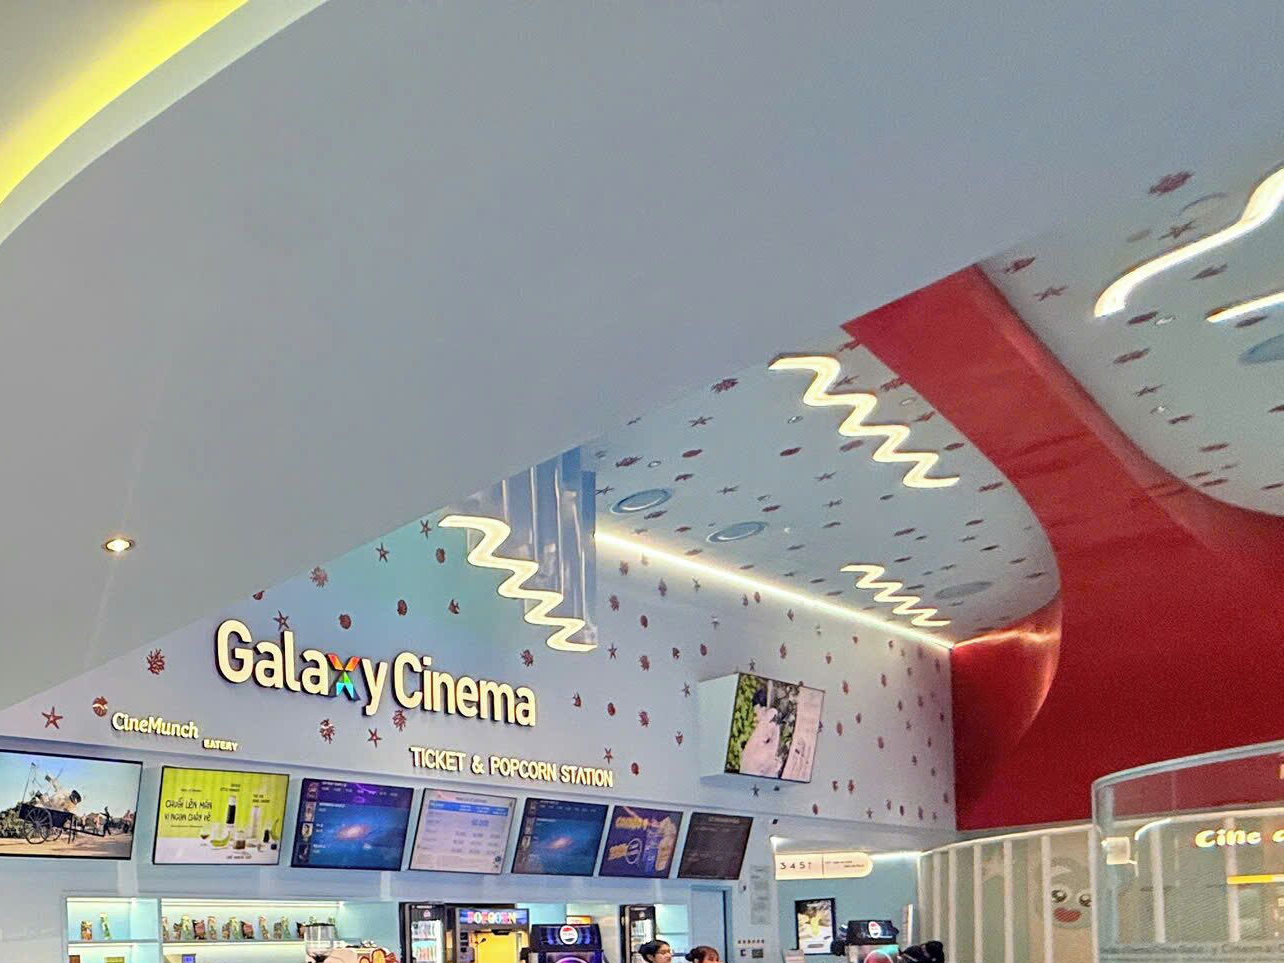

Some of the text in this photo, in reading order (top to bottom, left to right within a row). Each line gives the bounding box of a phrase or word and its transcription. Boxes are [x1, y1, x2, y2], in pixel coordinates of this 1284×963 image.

[216, 619, 536, 726] Galaxy Cinema
[111, 712, 199, 739] CineMunch
[202, 739, 238, 751] EATERY
[410, 746, 614, 788] TICKET & POPCORN STATION
[1195, 829, 1262, 848] Cine
[780, 862, 787, 870] 3
[799, 861, 806, 869] 5
